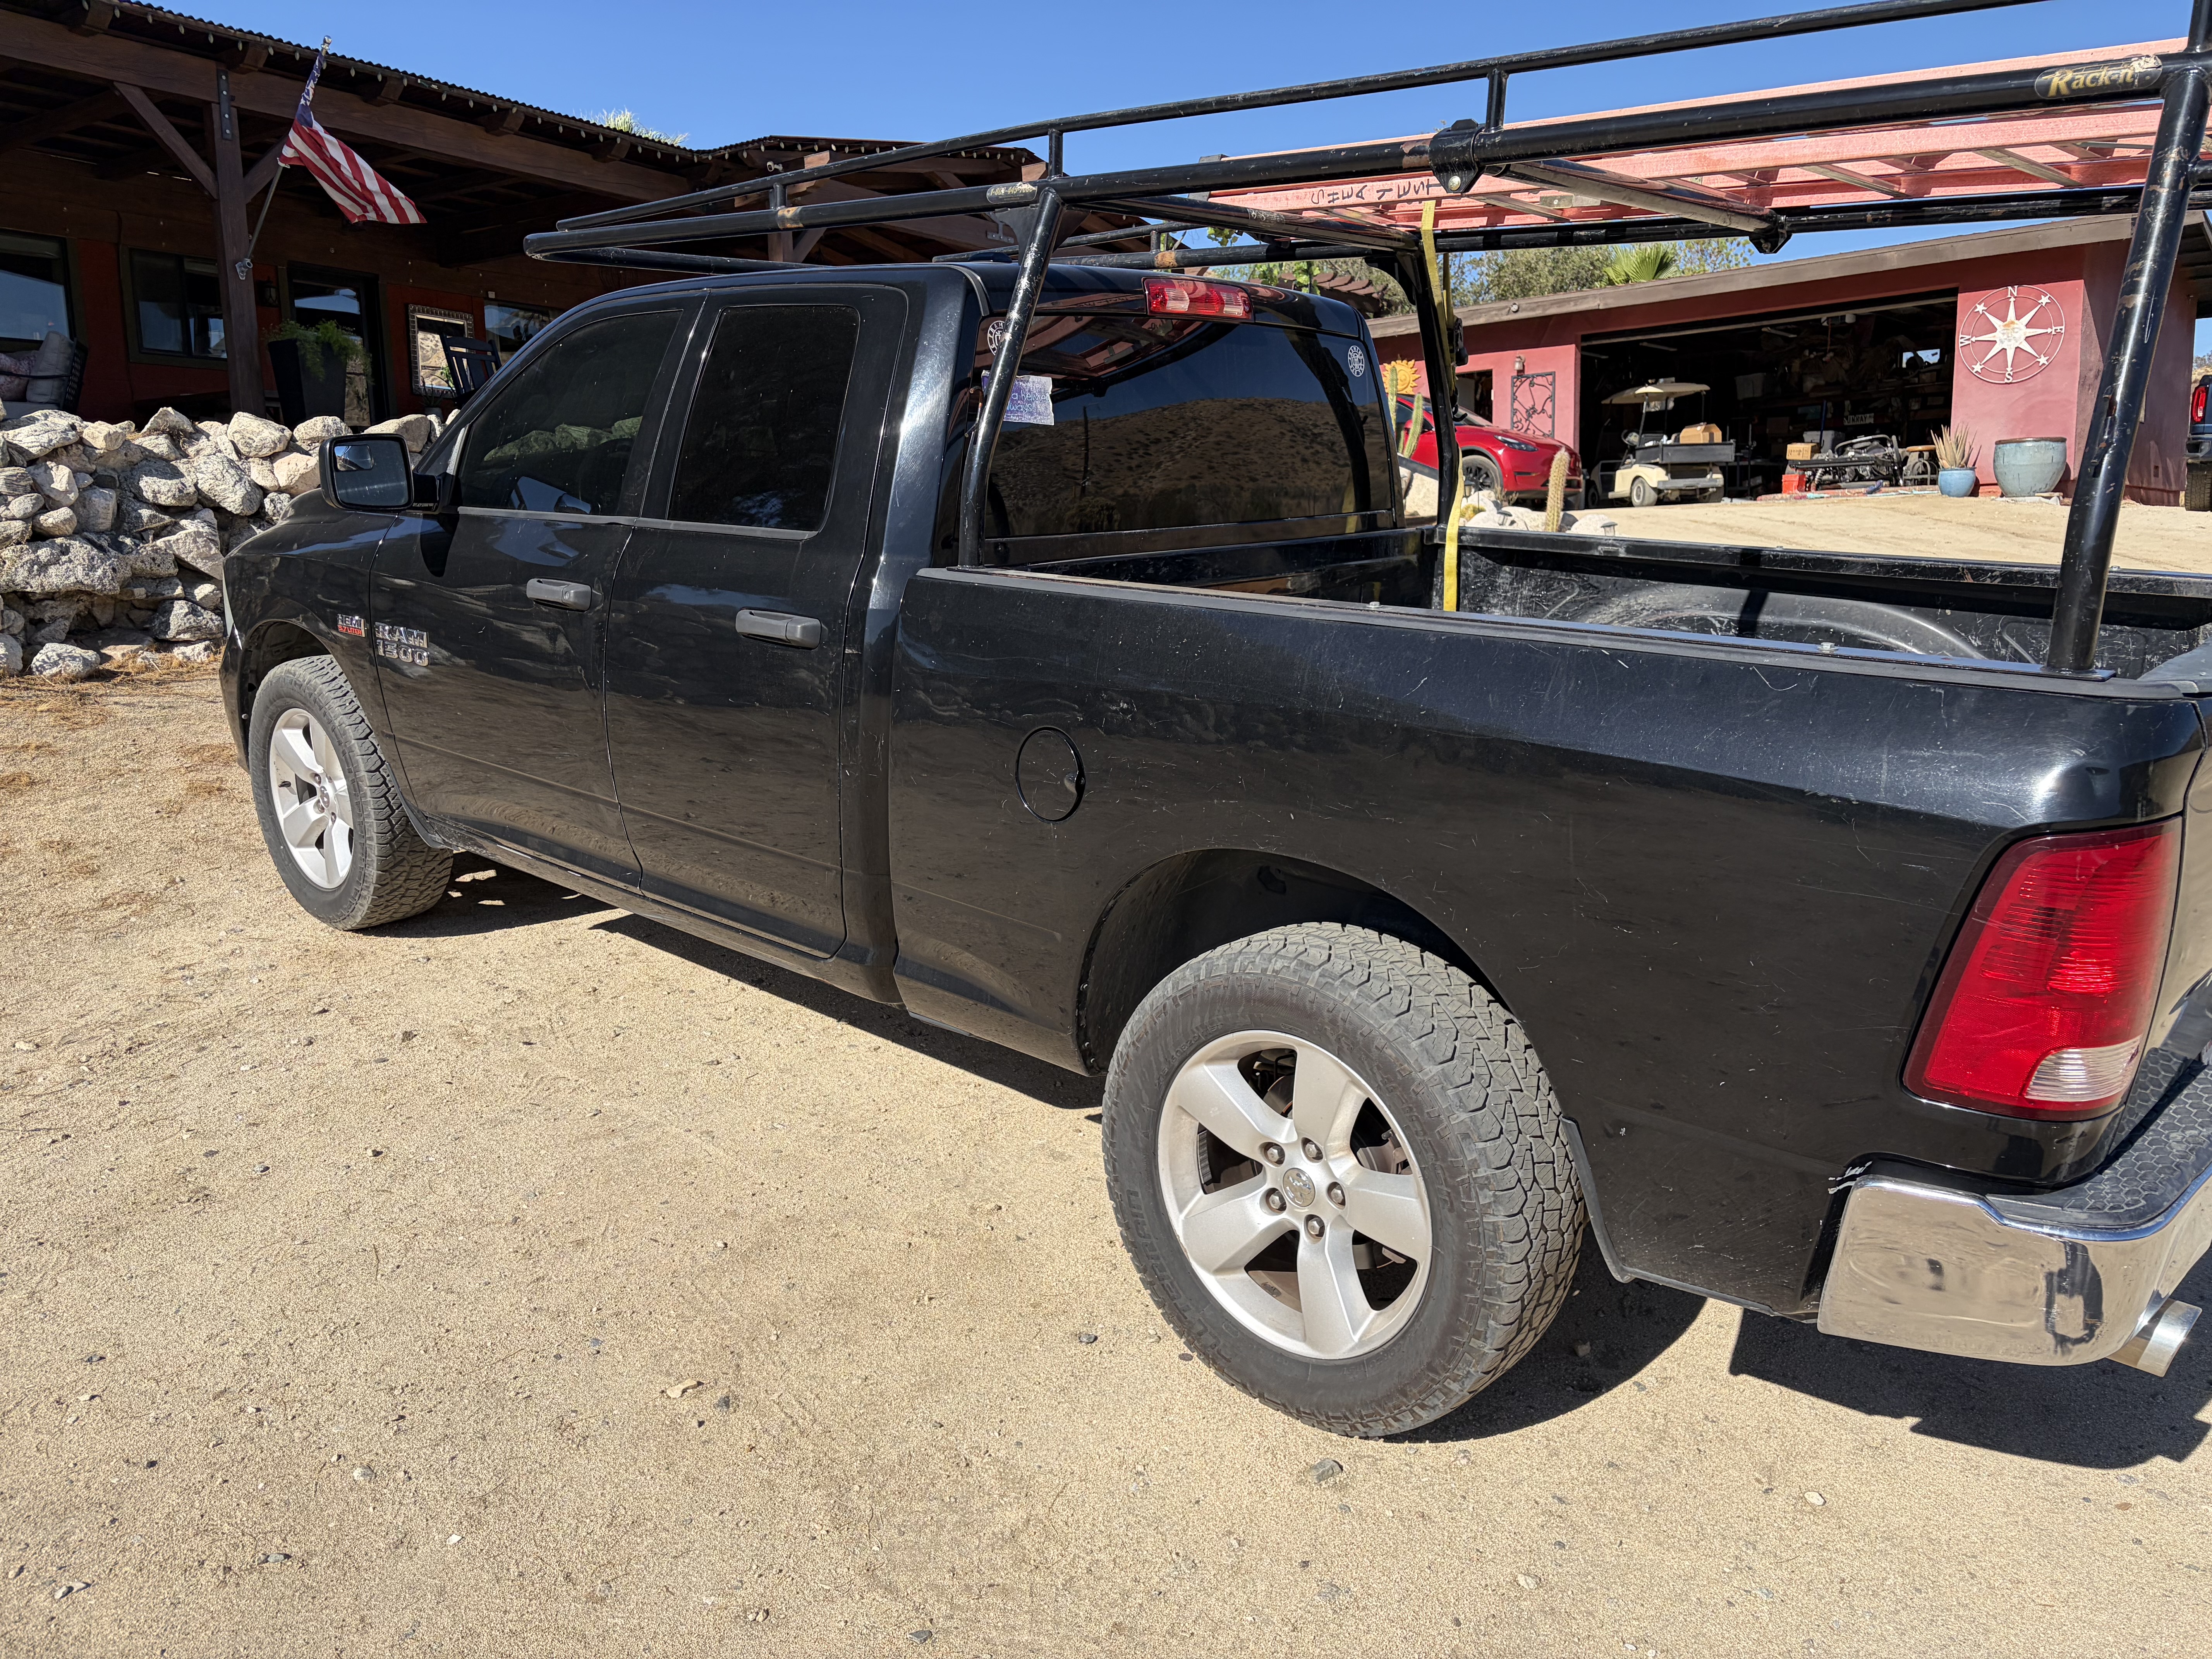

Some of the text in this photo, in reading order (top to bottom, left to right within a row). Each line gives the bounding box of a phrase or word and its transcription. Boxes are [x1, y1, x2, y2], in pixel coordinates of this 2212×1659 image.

[1007, 401, 1034, 414] lways!
[337, 614, 362, 629] HEMI
[347, 627, 363, 636] LITER
[375, 622, 428, 648] RAM
[376, 639, 429, 666] 1500
